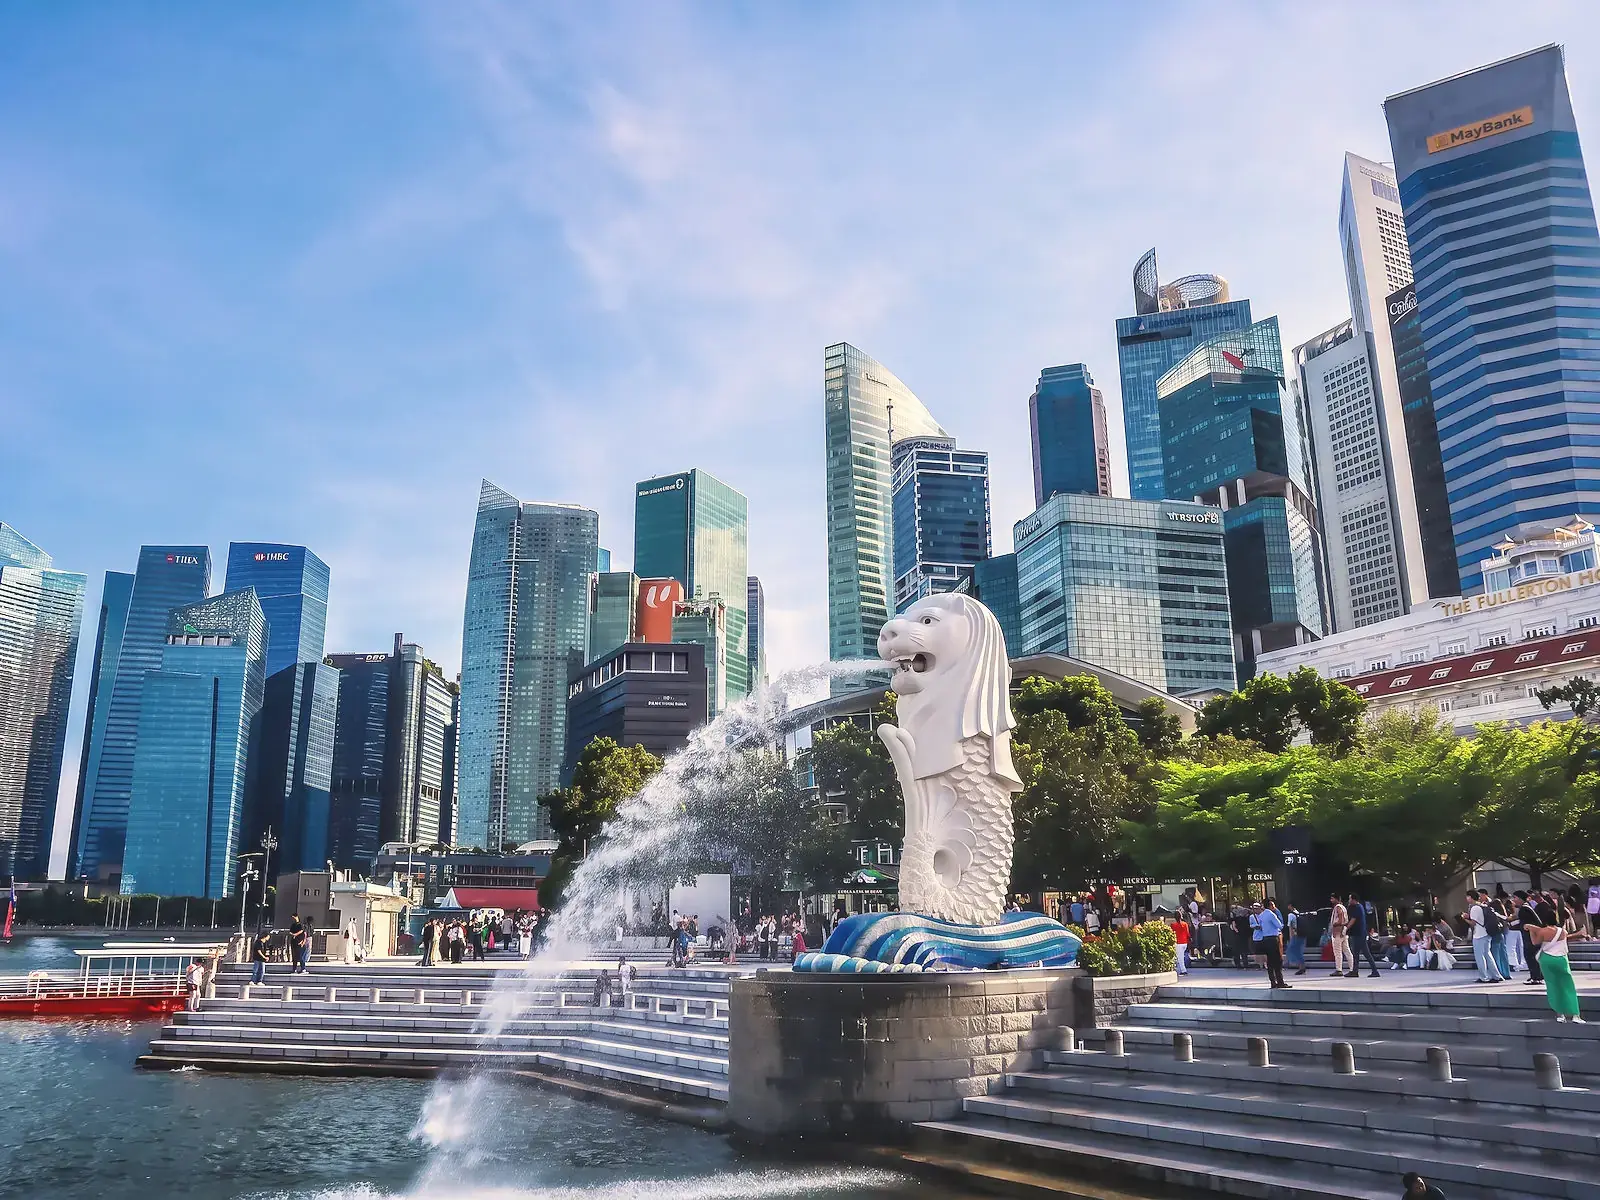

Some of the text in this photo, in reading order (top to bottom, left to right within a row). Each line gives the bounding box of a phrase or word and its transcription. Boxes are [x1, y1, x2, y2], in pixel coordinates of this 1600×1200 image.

[1450, 113, 1524, 143] MayBank
[1441, 600, 1471, 617] THE
[1476, 576, 1571, 609] FULLERTON
